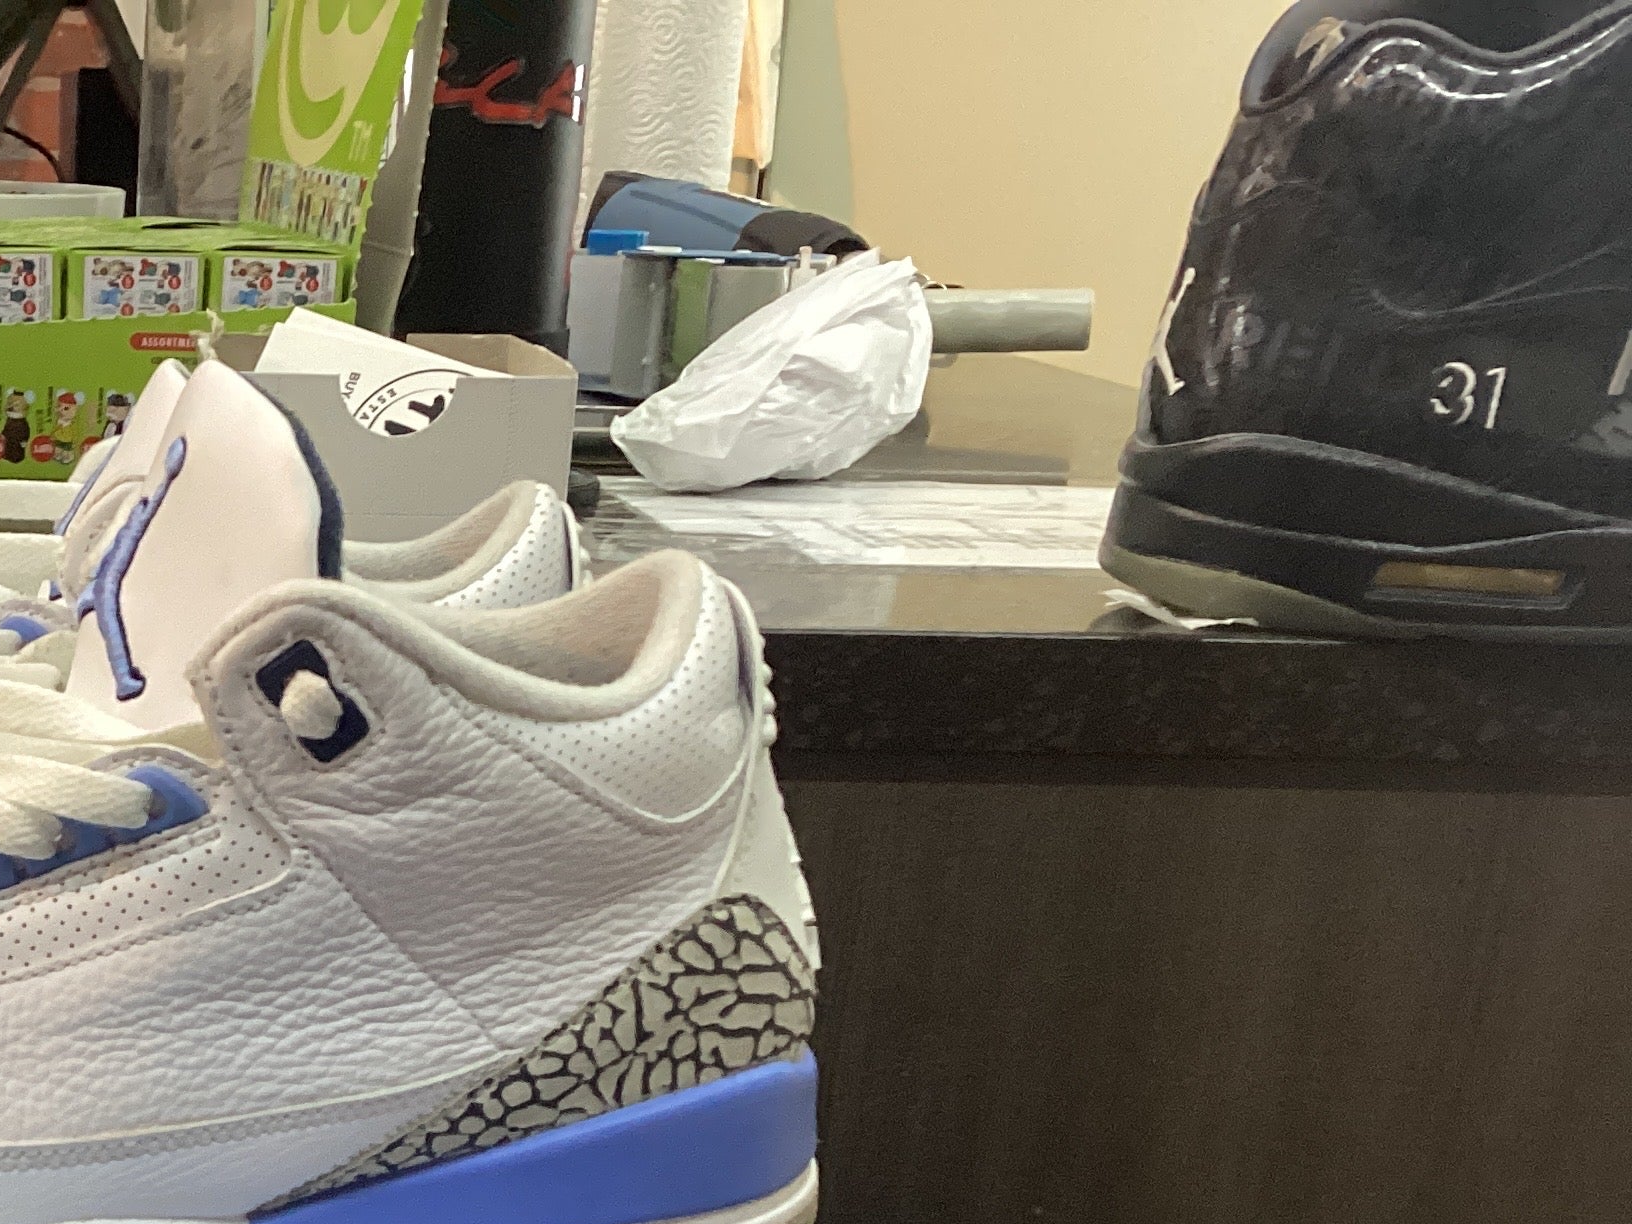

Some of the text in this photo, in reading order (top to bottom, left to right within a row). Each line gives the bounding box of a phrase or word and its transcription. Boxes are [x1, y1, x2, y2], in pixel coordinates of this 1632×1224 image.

[141, 336, 196, 348] ASSORTME
[342, 371, 361, 399] BUY
[1430, 361, 1507, 429] 31
